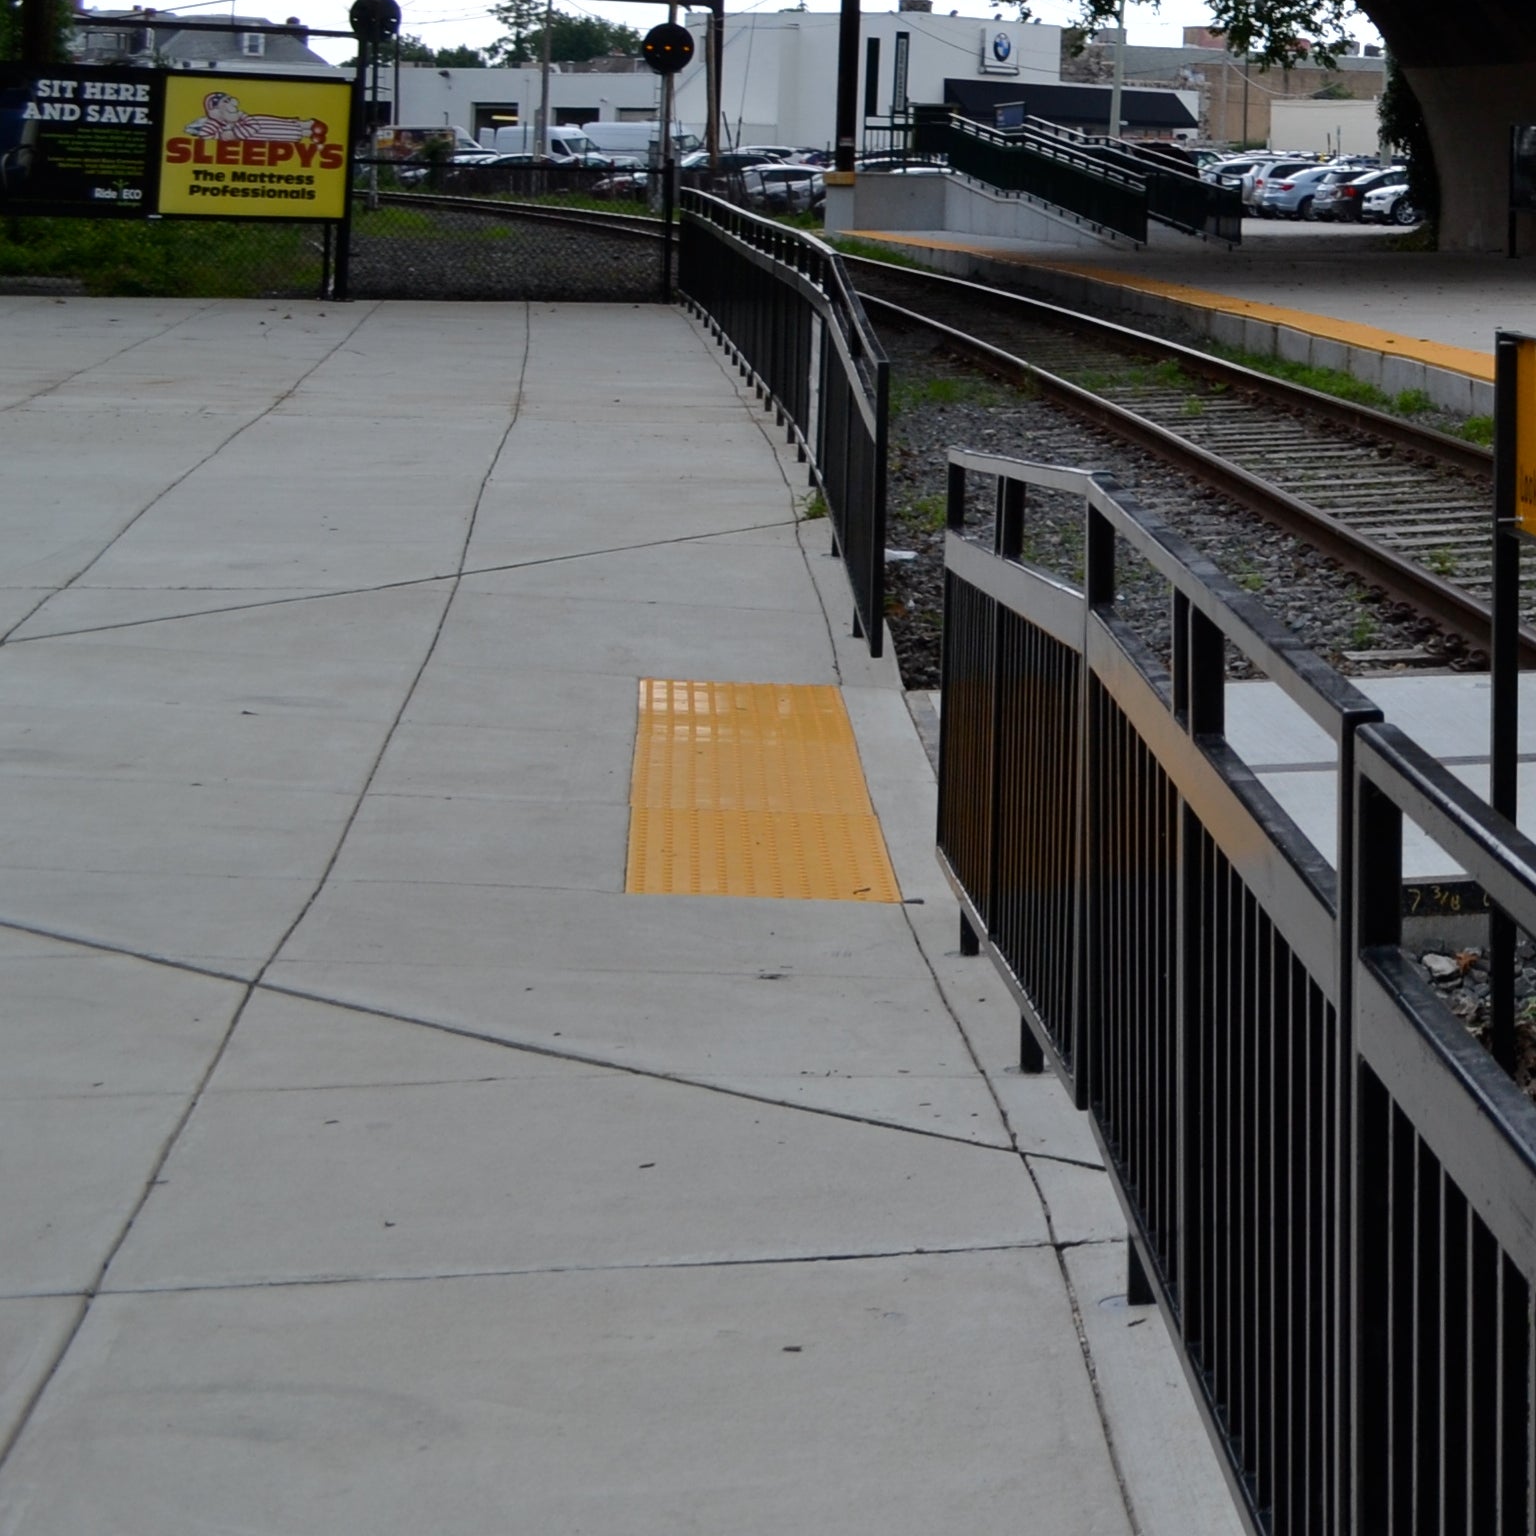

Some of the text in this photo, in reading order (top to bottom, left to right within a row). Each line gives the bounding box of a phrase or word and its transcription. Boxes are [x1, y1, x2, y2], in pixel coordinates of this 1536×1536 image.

[37, 79, 150, 102] SIT HERE
[22, 101, 153, 125] AND SAVE.
[192, 169, 315, 186] The Mattress
[94, 187, 143, 200] Ride ECO
[188, 184, 316, 201] Professionals
